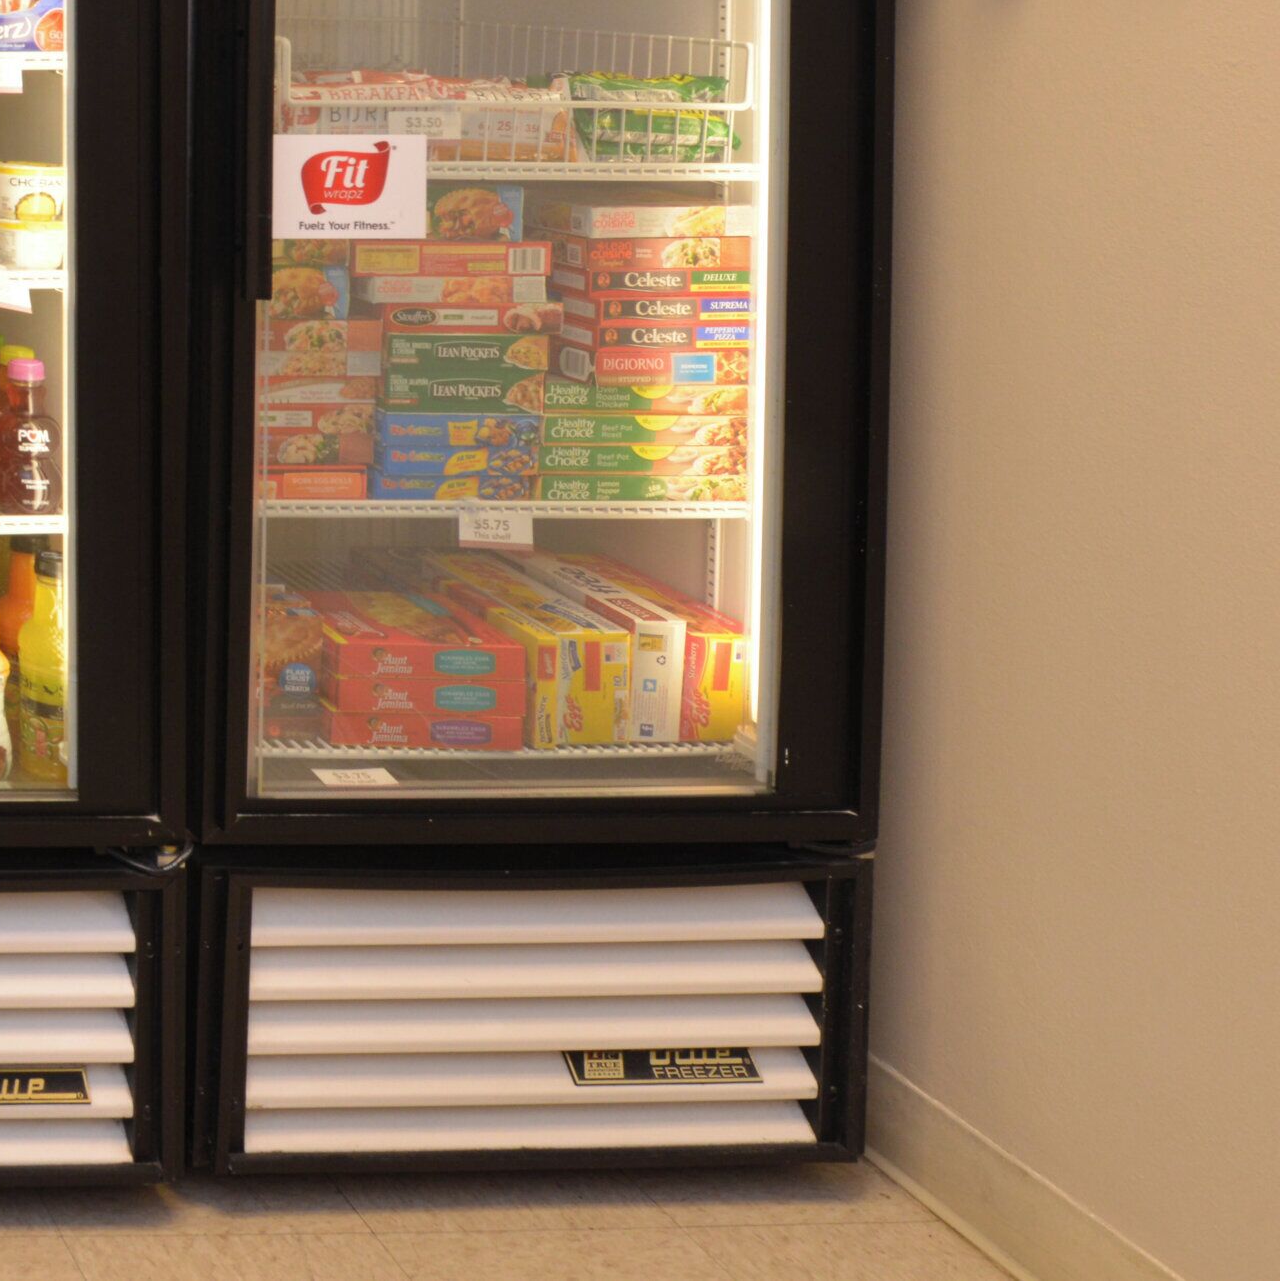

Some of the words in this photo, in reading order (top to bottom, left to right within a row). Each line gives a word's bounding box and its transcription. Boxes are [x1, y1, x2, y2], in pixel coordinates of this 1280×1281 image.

[406, 117, 442, 128] $3.50
[321, 154, 369, 190] Fit
[324, 188, 365, 201] wrapz
[299, 221, 324, 231] Fuelz
[327, 221, 352, 231] Your
[624, 272, 681, 287] Celeste
[703, 273, 736, 282] DELUXE
[636, 300, 691, 316] Celeste
[710, 301, 748, 310] SUPREMA
[632, 329, 688, 344] Celeste
[438, 346, 457, 357] LEAN
[461, 346, 499, 357] POCKETS
[603, 358, 663, 370] DiGIORNO
[433, 384, 457, 396] LEAN
[458, 384, 501, 397] POCKETS
[551, 385, 589, 395] Healthy
[545, 393, 588, 405] Choice
[596, 400, 629, 408] Chicken
[558, 419, 595, 429] Healthy
[552, 428, 594, 438] Choice
[552, 448, 590, 456] Healthy
[546, 456, 589, 466] Choice
[553, 481, 589, 490] Healthy
[548, 489, 589, 500] Choice
[473, 519, 509, 531] $5.75
[384, 654, 408, 665] Aunt
[374, 664, 413, 674] Jemima
[384, 690, 408, 701] Aunt
[375, 699, 413, 710] Jemima
[379, 724, 402, 733] Aunt
[369, 733, 408, 743] Jemima
[654, 1066, 748, 1078] FREEZER
